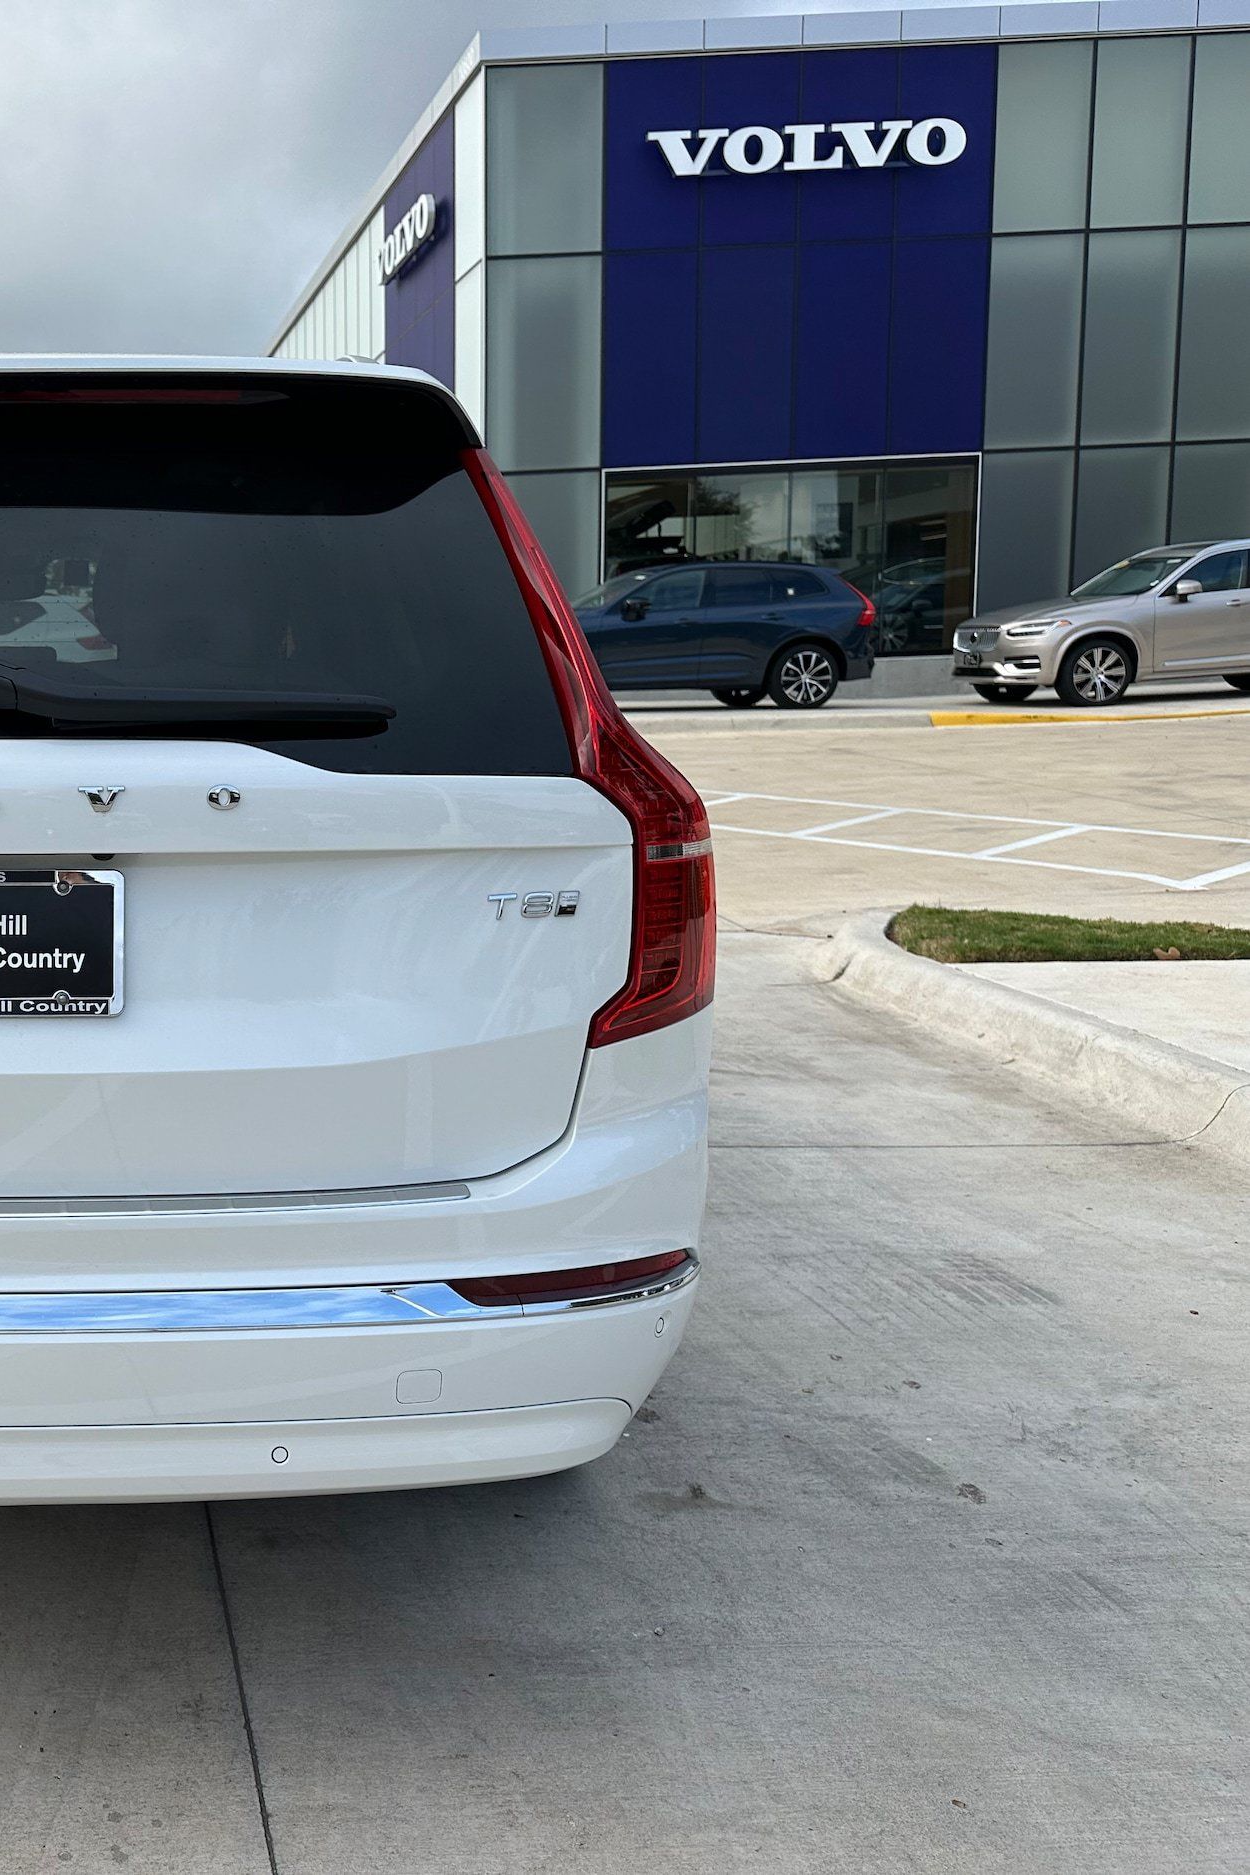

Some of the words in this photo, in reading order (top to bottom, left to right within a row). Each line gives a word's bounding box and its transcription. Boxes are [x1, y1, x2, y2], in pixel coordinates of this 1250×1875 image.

[646, 117, 967, 177] VOLVO
[375, 193, 434, 285] VOLVO
[19, 1000, 108, 1014] Country
